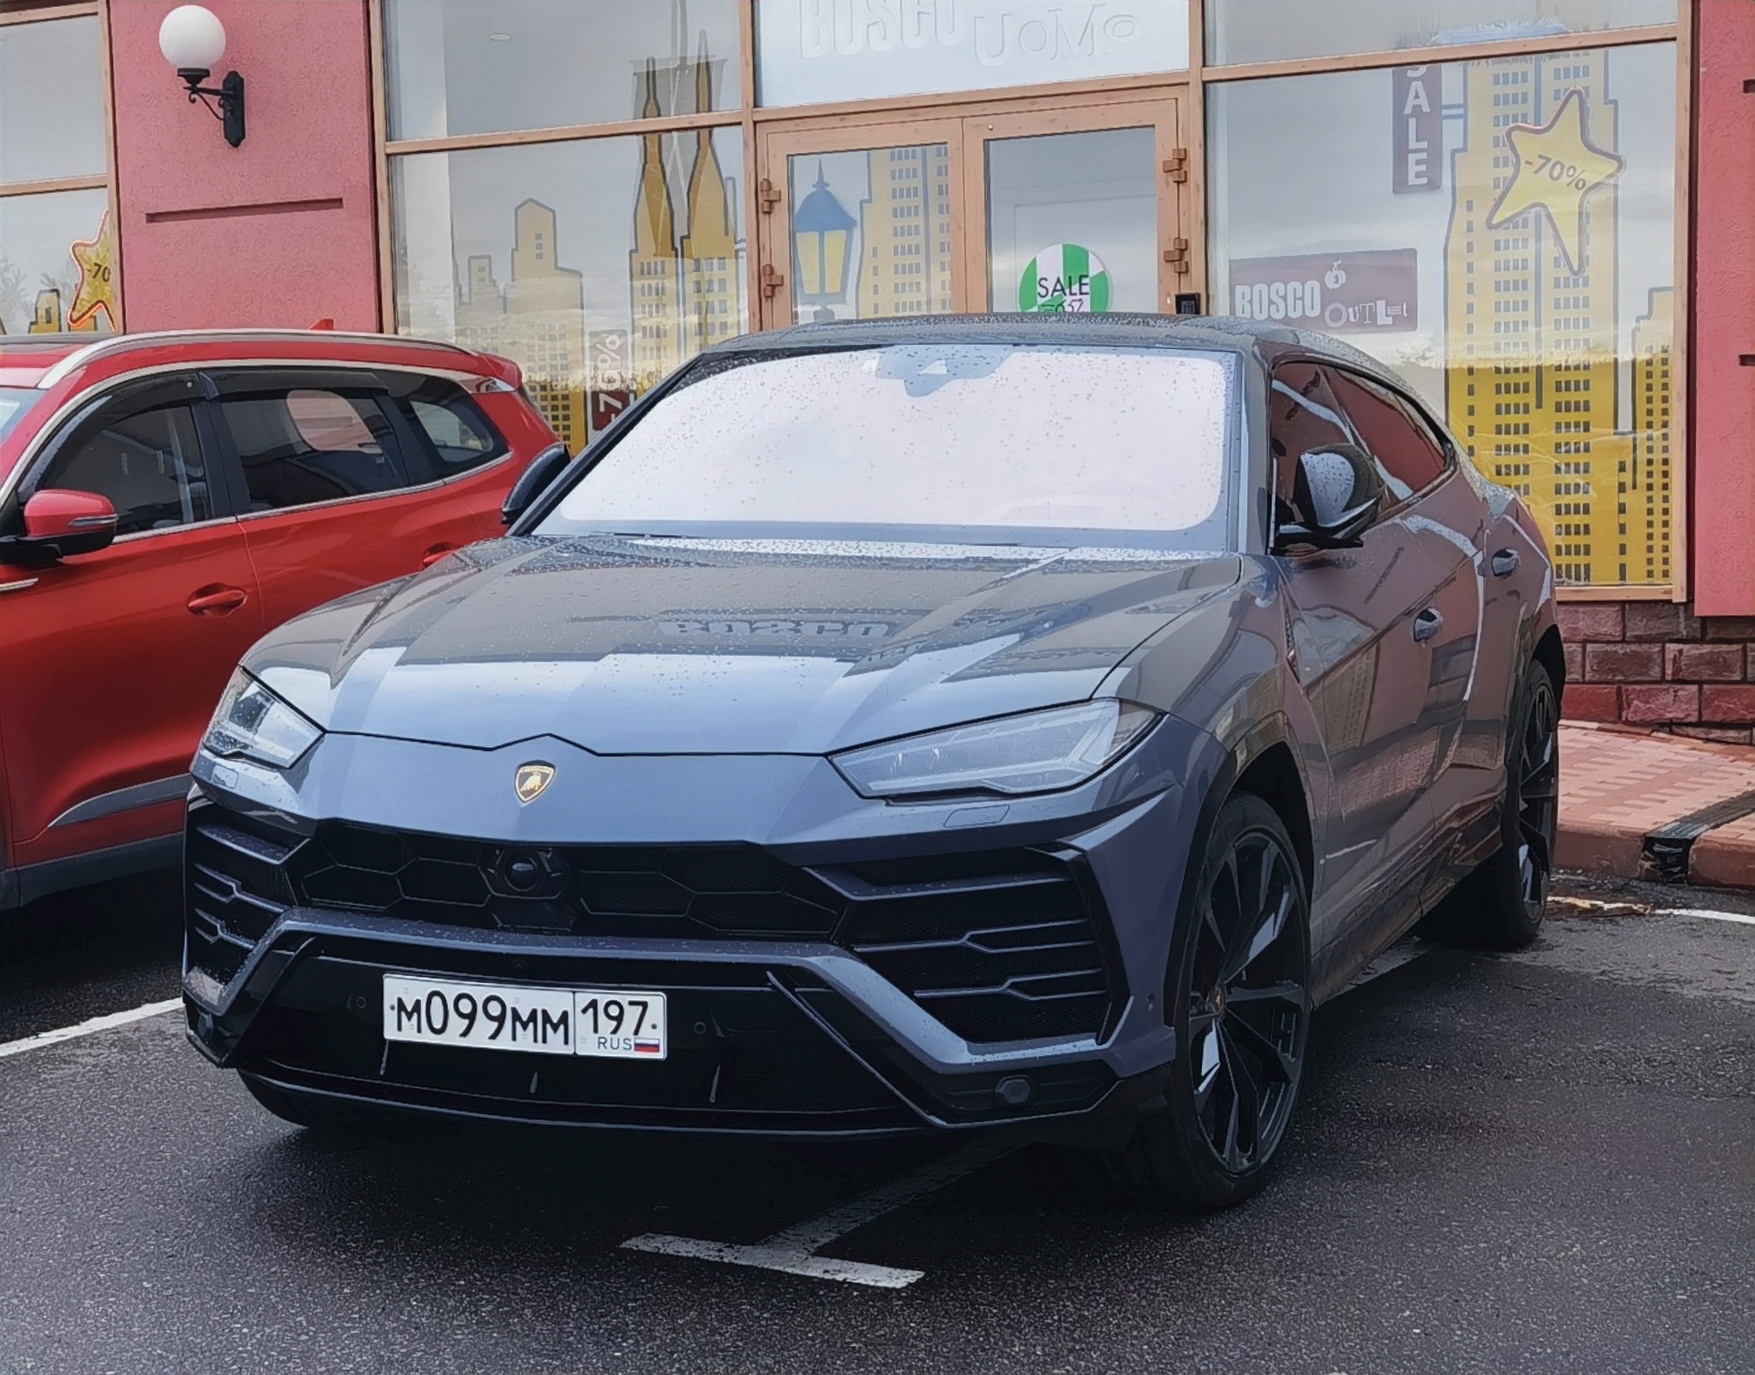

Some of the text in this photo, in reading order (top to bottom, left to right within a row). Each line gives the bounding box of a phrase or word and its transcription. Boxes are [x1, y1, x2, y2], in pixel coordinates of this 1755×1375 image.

[800, 0, 966, 58] BOSCO
[1525, 154, 1586, 190] -70%
[1037, 274, 1090, 298] SALE
[1235, 280, 1321, 320] BOSCO
[581, 998, 649, 1036] 197
[597, 1036, 633, 1050] RUS
